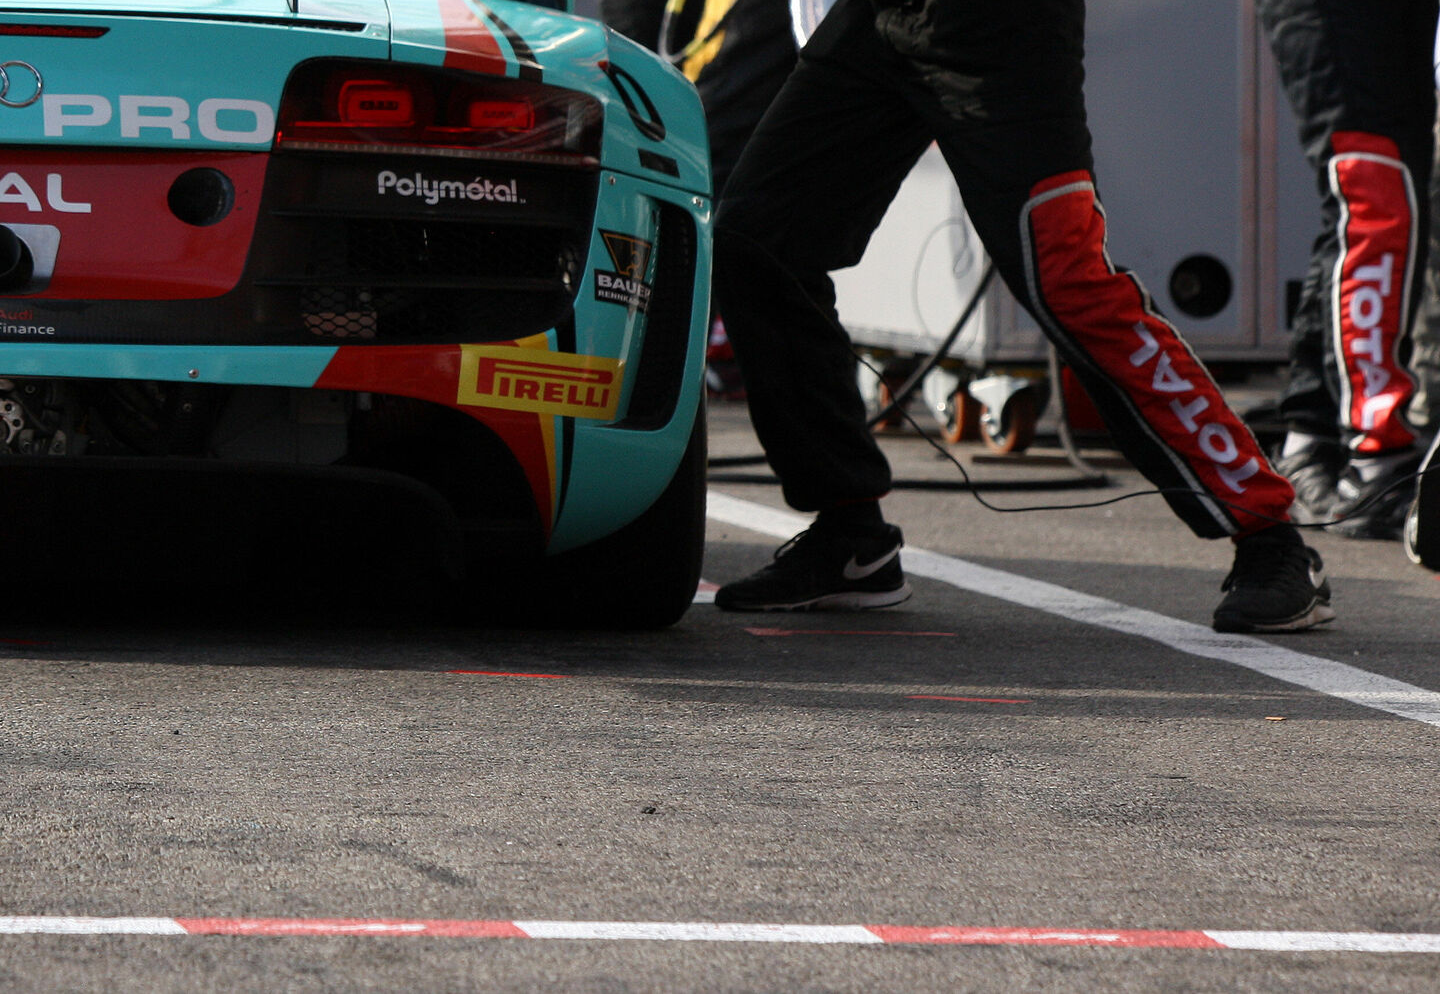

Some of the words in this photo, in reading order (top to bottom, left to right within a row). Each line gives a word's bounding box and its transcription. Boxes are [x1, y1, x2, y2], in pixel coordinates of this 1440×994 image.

[42, 94, 275, 143] PRO
[377, 170, 517, 206] Polymétal
[1350, 252, 1394, 430] TOTAL
[476, 357, 613, 409] PIRELLI
[1128, 321, 1262, 494] TOTAL
